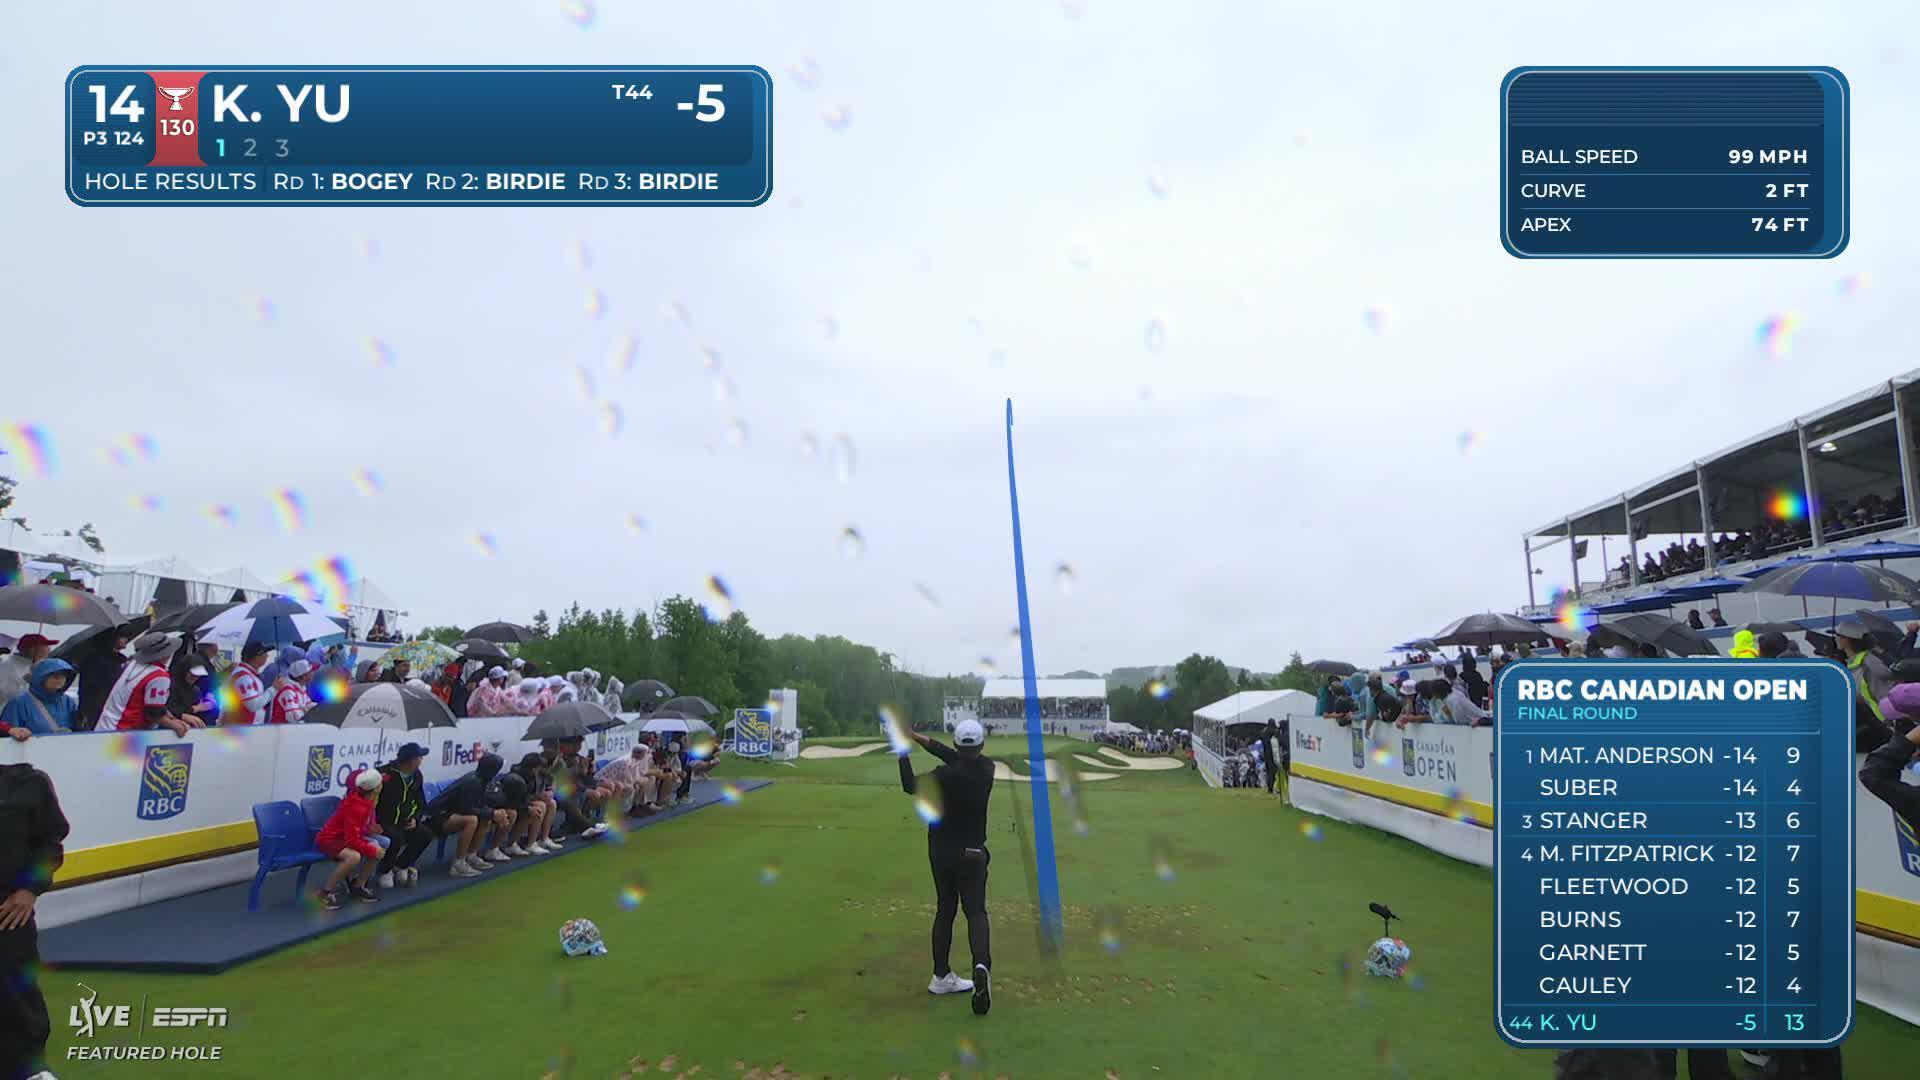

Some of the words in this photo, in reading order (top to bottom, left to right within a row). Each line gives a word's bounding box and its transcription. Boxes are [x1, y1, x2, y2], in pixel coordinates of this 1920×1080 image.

[607, 735, 631, 753] OPEN
[738, 741, 768, 753] RBC
[1416, 737, 1455, 755] CANADIAN
[1417, 756, 1457, 782] OPEN
[306, 779, 329, 793] RBC
[142, 795, 184, 816] RBC
